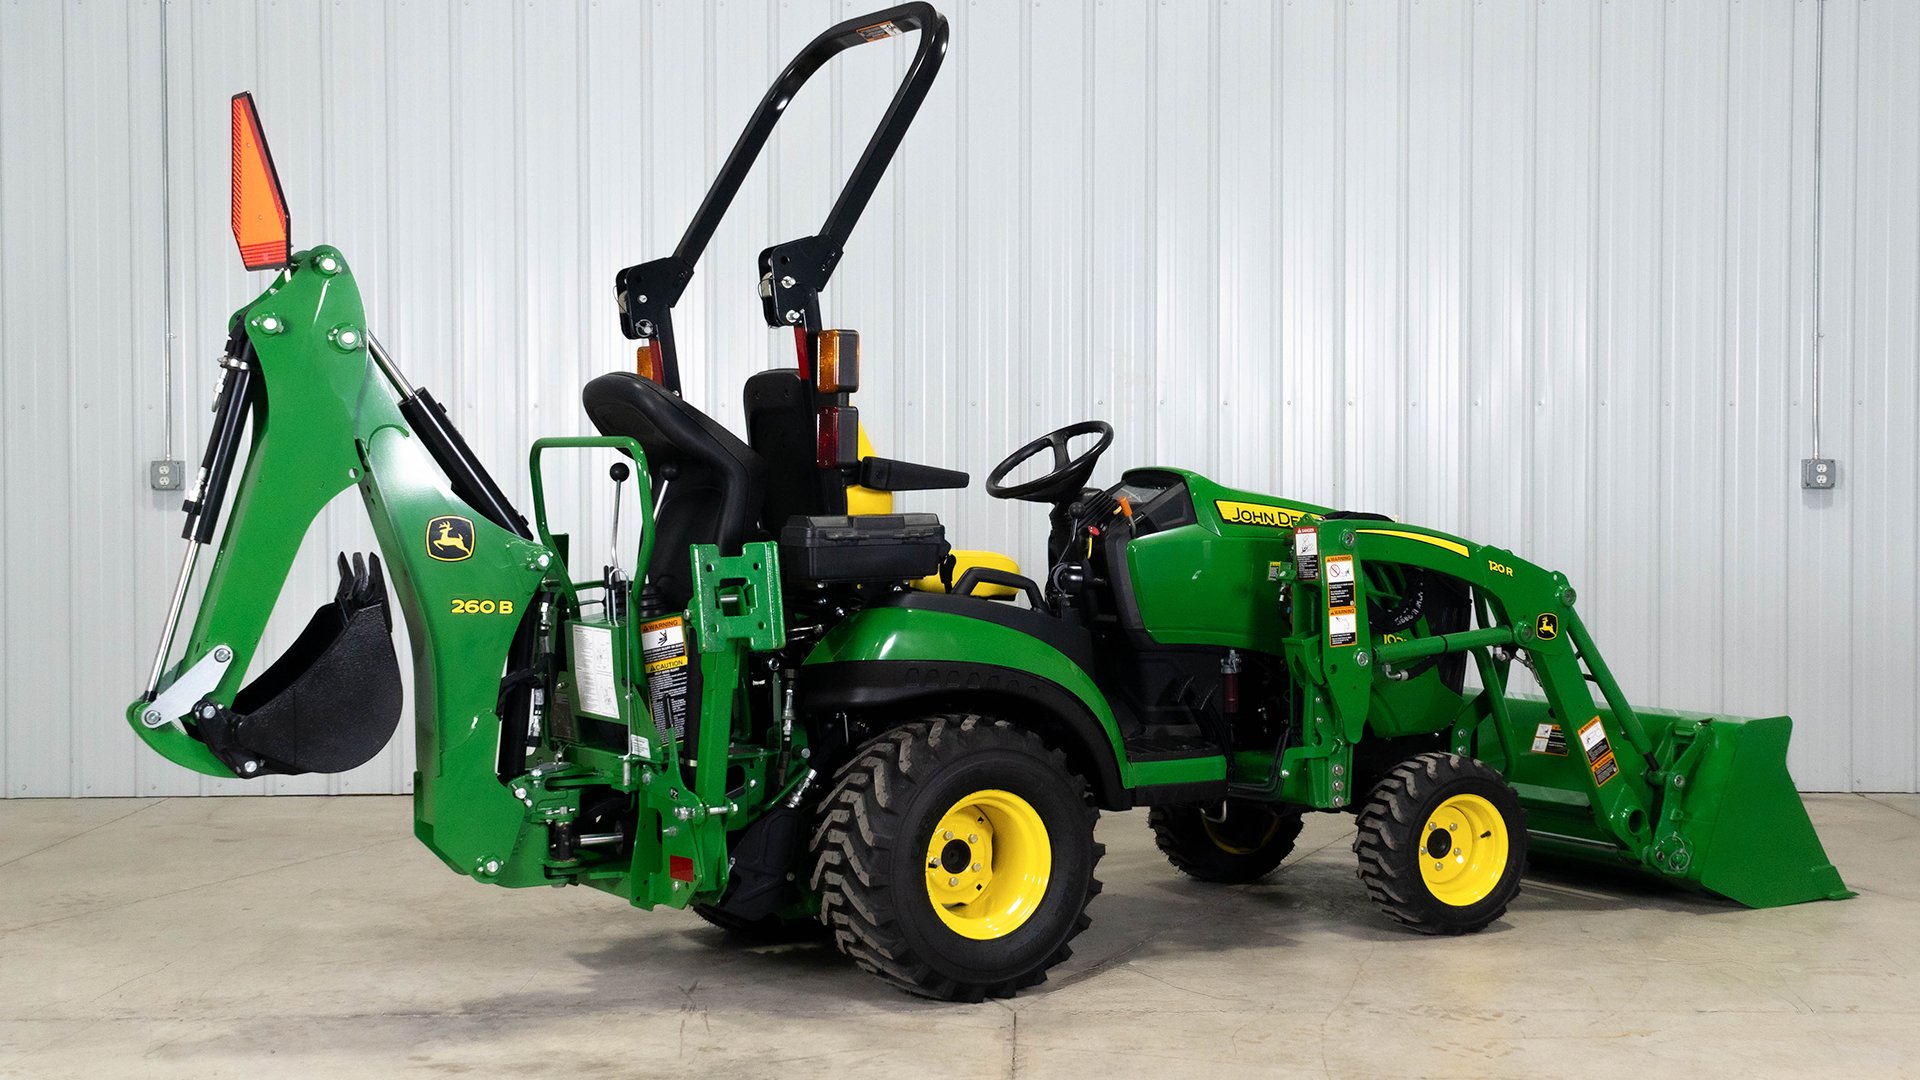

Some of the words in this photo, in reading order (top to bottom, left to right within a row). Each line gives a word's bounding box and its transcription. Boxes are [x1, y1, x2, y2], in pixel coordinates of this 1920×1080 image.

[1232, 507, 1275, 524] JOHN
[1488, 560, 1505, 573] 120
[1506, 566, 1513, 577] R
[451, 599, 496, 614] 260
[499, 600, 514, 614] B
[650, 620, 678, 631] WARNING
[655, 660, 683, 670] CAUTION
